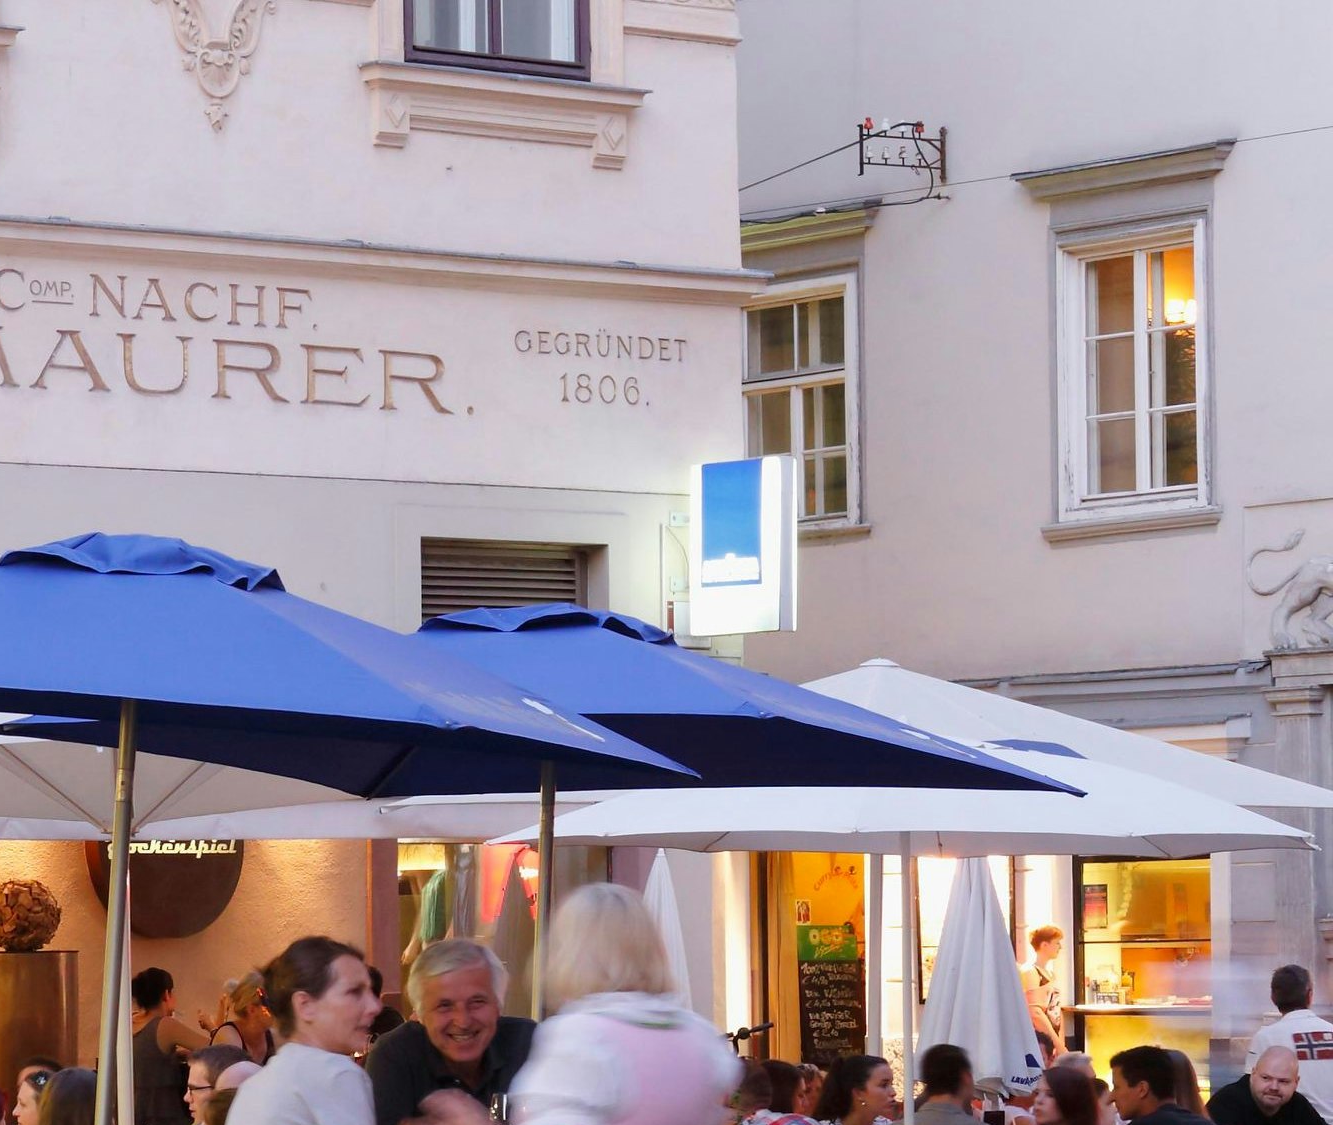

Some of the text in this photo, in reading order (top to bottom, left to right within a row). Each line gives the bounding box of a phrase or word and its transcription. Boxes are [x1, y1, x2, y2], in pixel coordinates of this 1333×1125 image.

[89, 272, 319, 331] NACHF.
[513, 327, 689, 364] GEGRÜNDET
[558, 373, 651, 406] 1806.
